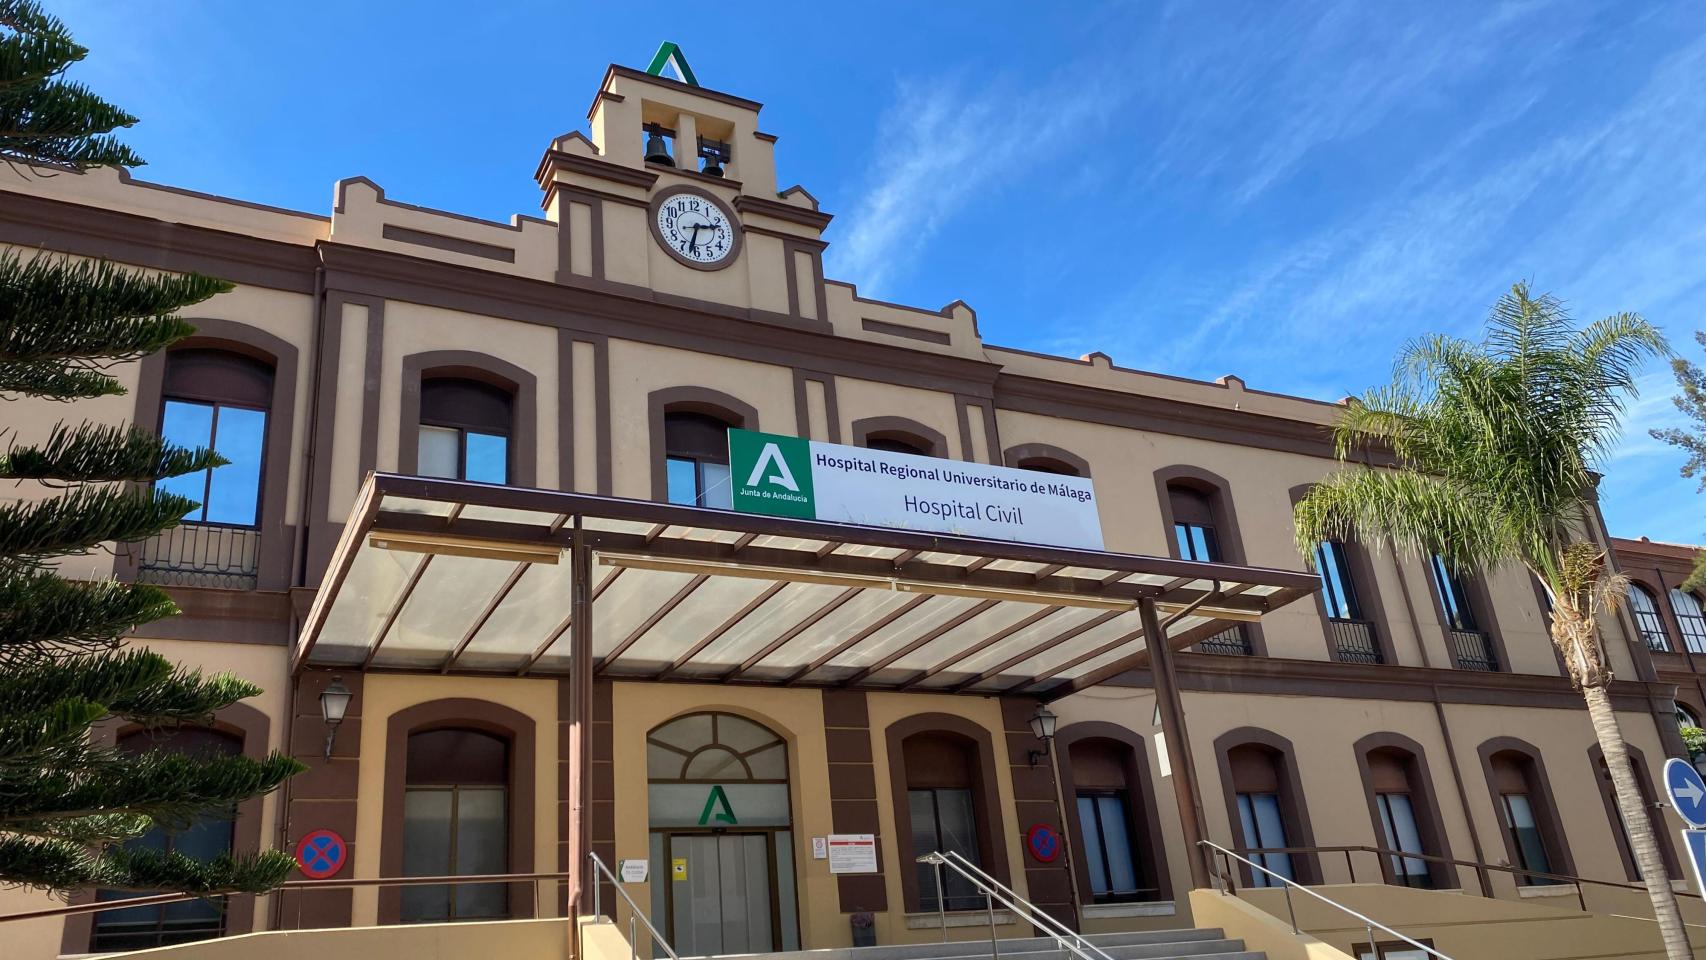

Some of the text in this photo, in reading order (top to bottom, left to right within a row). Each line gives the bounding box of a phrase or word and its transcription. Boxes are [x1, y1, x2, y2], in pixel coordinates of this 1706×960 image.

[667, 206, 678, 218] 10
[678, 201, 686, 212] 11
[689, 200, 700, 212] 12
[705, 206, 710, 218] 1
[666, 217, 673, 229] 9
[714, 216, 721, 226] 2
[670, 229, 678, 241] 8
[718, 228, 725, 240] 3
[680, 240, 687, 251] 7
[693, 245, 701, 258] 6
[706, 246, 714, 257] 5
[715, 240, 723, 251] 4
[816, 453, 1092, 502] Hospital Regional Universitario de Málaga
[740, 487, 808, 503] Junta de Andalucía
[904, 494, 1024, 525] Hospital Civil
